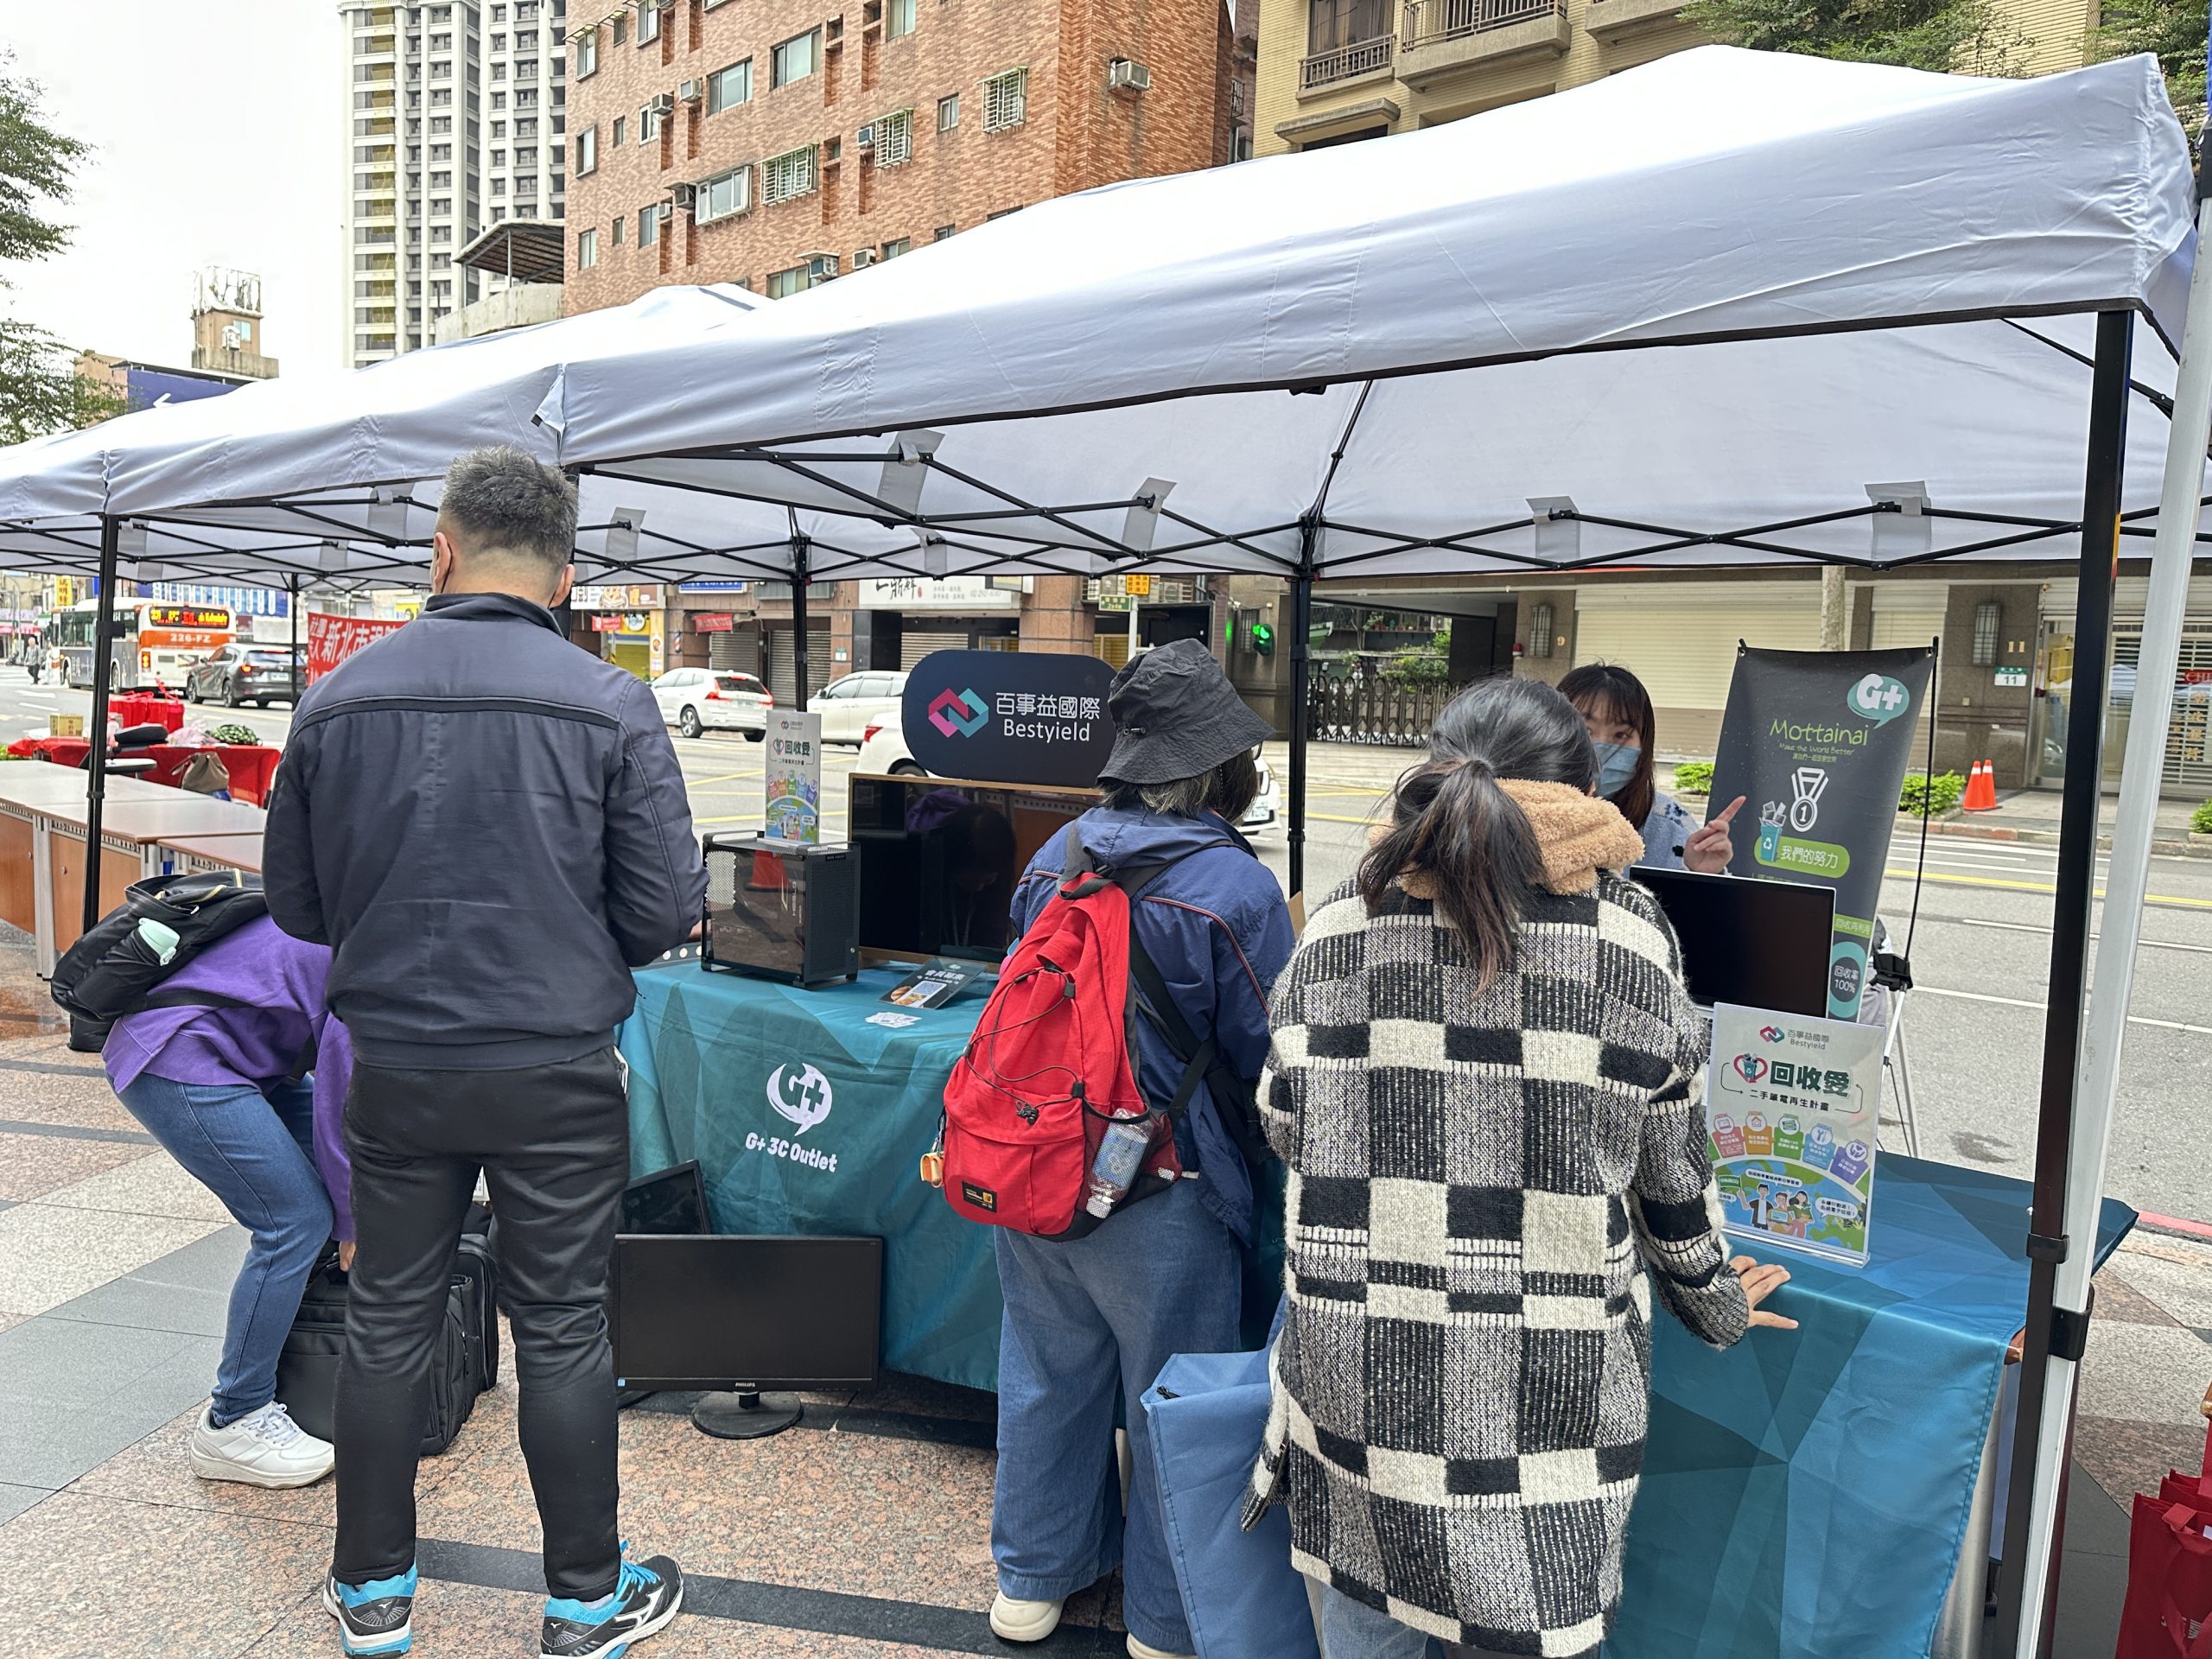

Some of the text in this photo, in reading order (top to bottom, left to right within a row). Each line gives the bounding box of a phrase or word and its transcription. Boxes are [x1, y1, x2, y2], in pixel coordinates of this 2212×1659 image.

[170, 632, 212, 644] 226-FZ
[1557, 636, 1565, 646] 9
[2004, 676, 2018, 685] 11
[1857, 673, 1903, 711] G+
[996, 691, 1101, 720] 百事益國際
[1003, 719, 1090, 743] Bestyield
[1770, 718, 1870, 747] Mottainai
[1779, 742, 1796, 751] Make
[1800, 804, 1808, 822] 1
[1781, 845, 1839, 869] 我們的努力
[1834, 965, 1859, 980] 回收率
[1834, 979, 1856, 994] 100%
[1790, 1038, 1826, 1050] Bestyield
[778, 1062, 825, 1114] G+
[1770, 1060, 1850, 1098] 回收愛
[746, 1132, 837, 1173] G+ 3C Outlet
